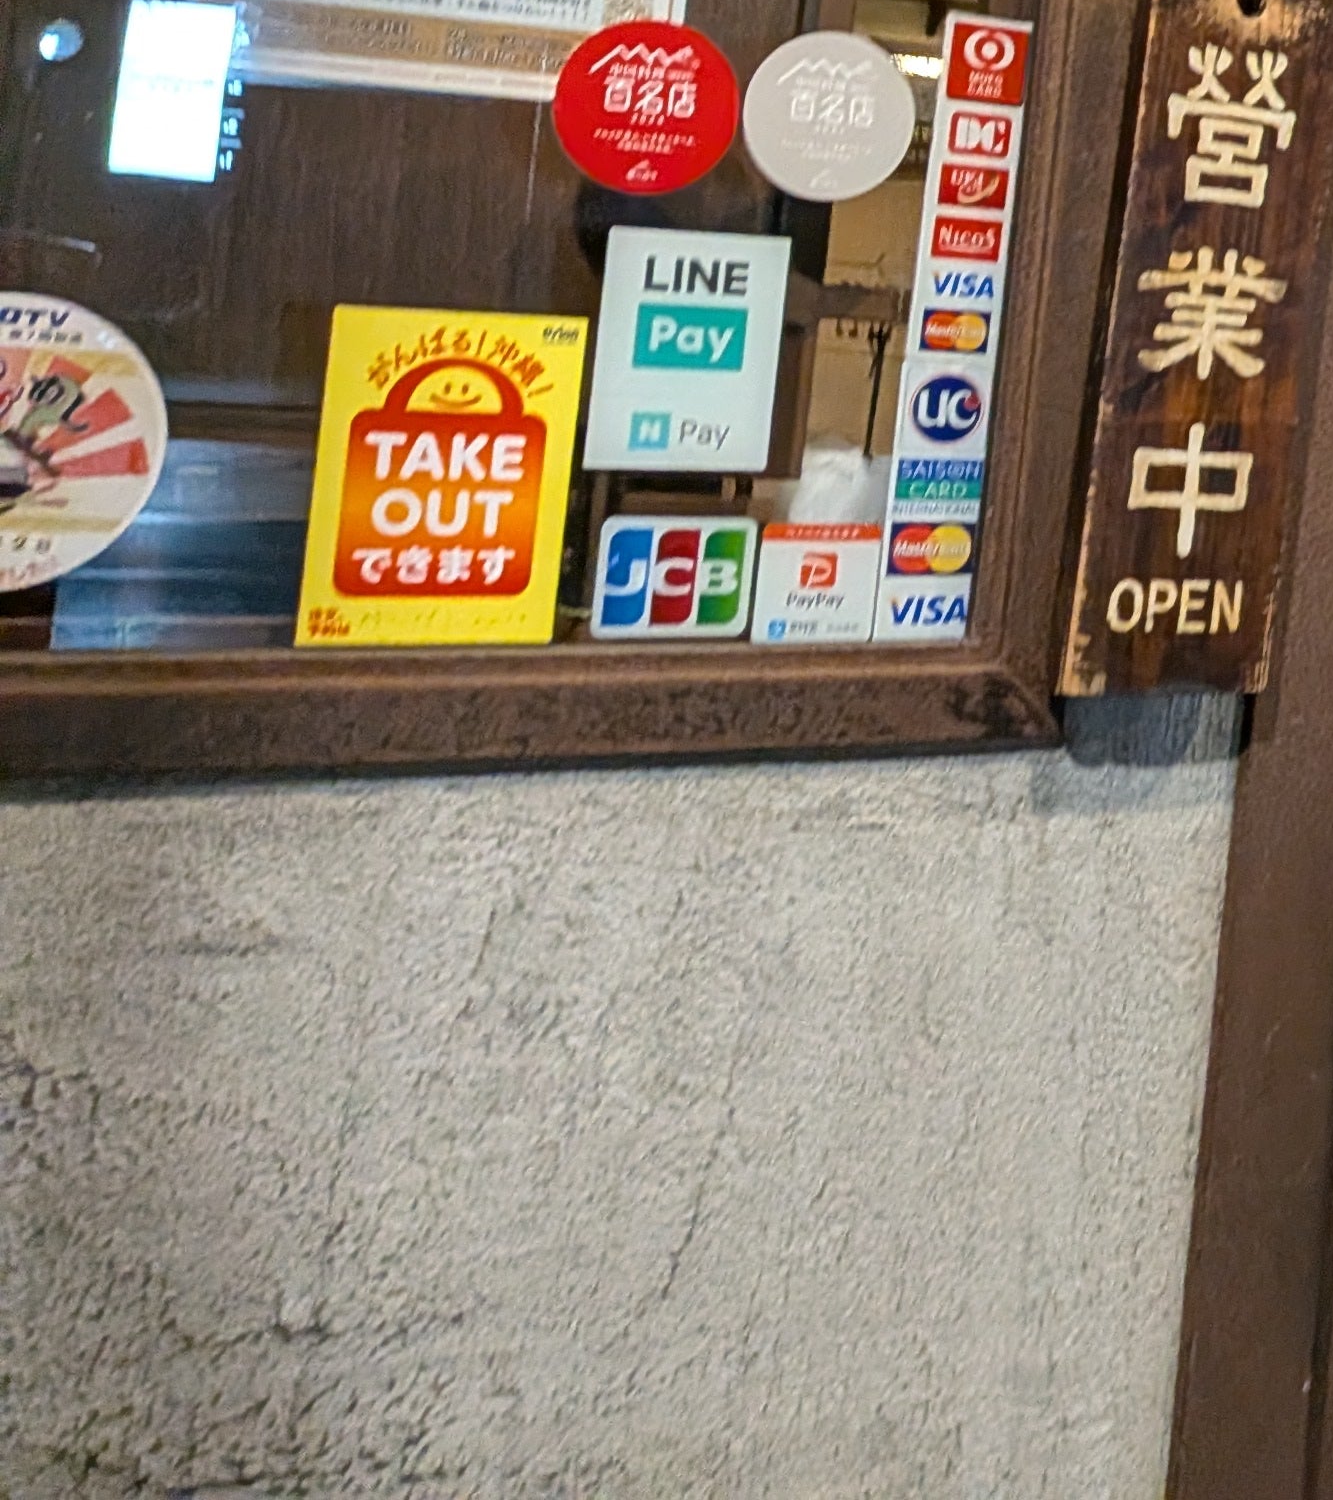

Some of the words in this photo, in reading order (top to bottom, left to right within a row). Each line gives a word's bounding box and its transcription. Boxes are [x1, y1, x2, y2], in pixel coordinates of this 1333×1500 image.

[603, 77, 698, 119] 百名店
[790, 89, 874, 128] 百名店
[955, 116, 1005, 153] DC
[643, 255, 750, 297] LINE
[932, 272, 995, 299] VISA
[648, 314, 734, 364] Pay
[917, 387, 979, 430] UC
[679, 418, 731, 451] Pay
[364, 430, 528, 482] TAKE
[907, 480, 969, 499] CARD
[371, 487, 515, 539] OUT
[351, 544, 517, 585] できます
[603, 555, 740, 598] JCB
[890, 594, 968, 626] VISA
[1106, 576, 1244, 635] OPEN
